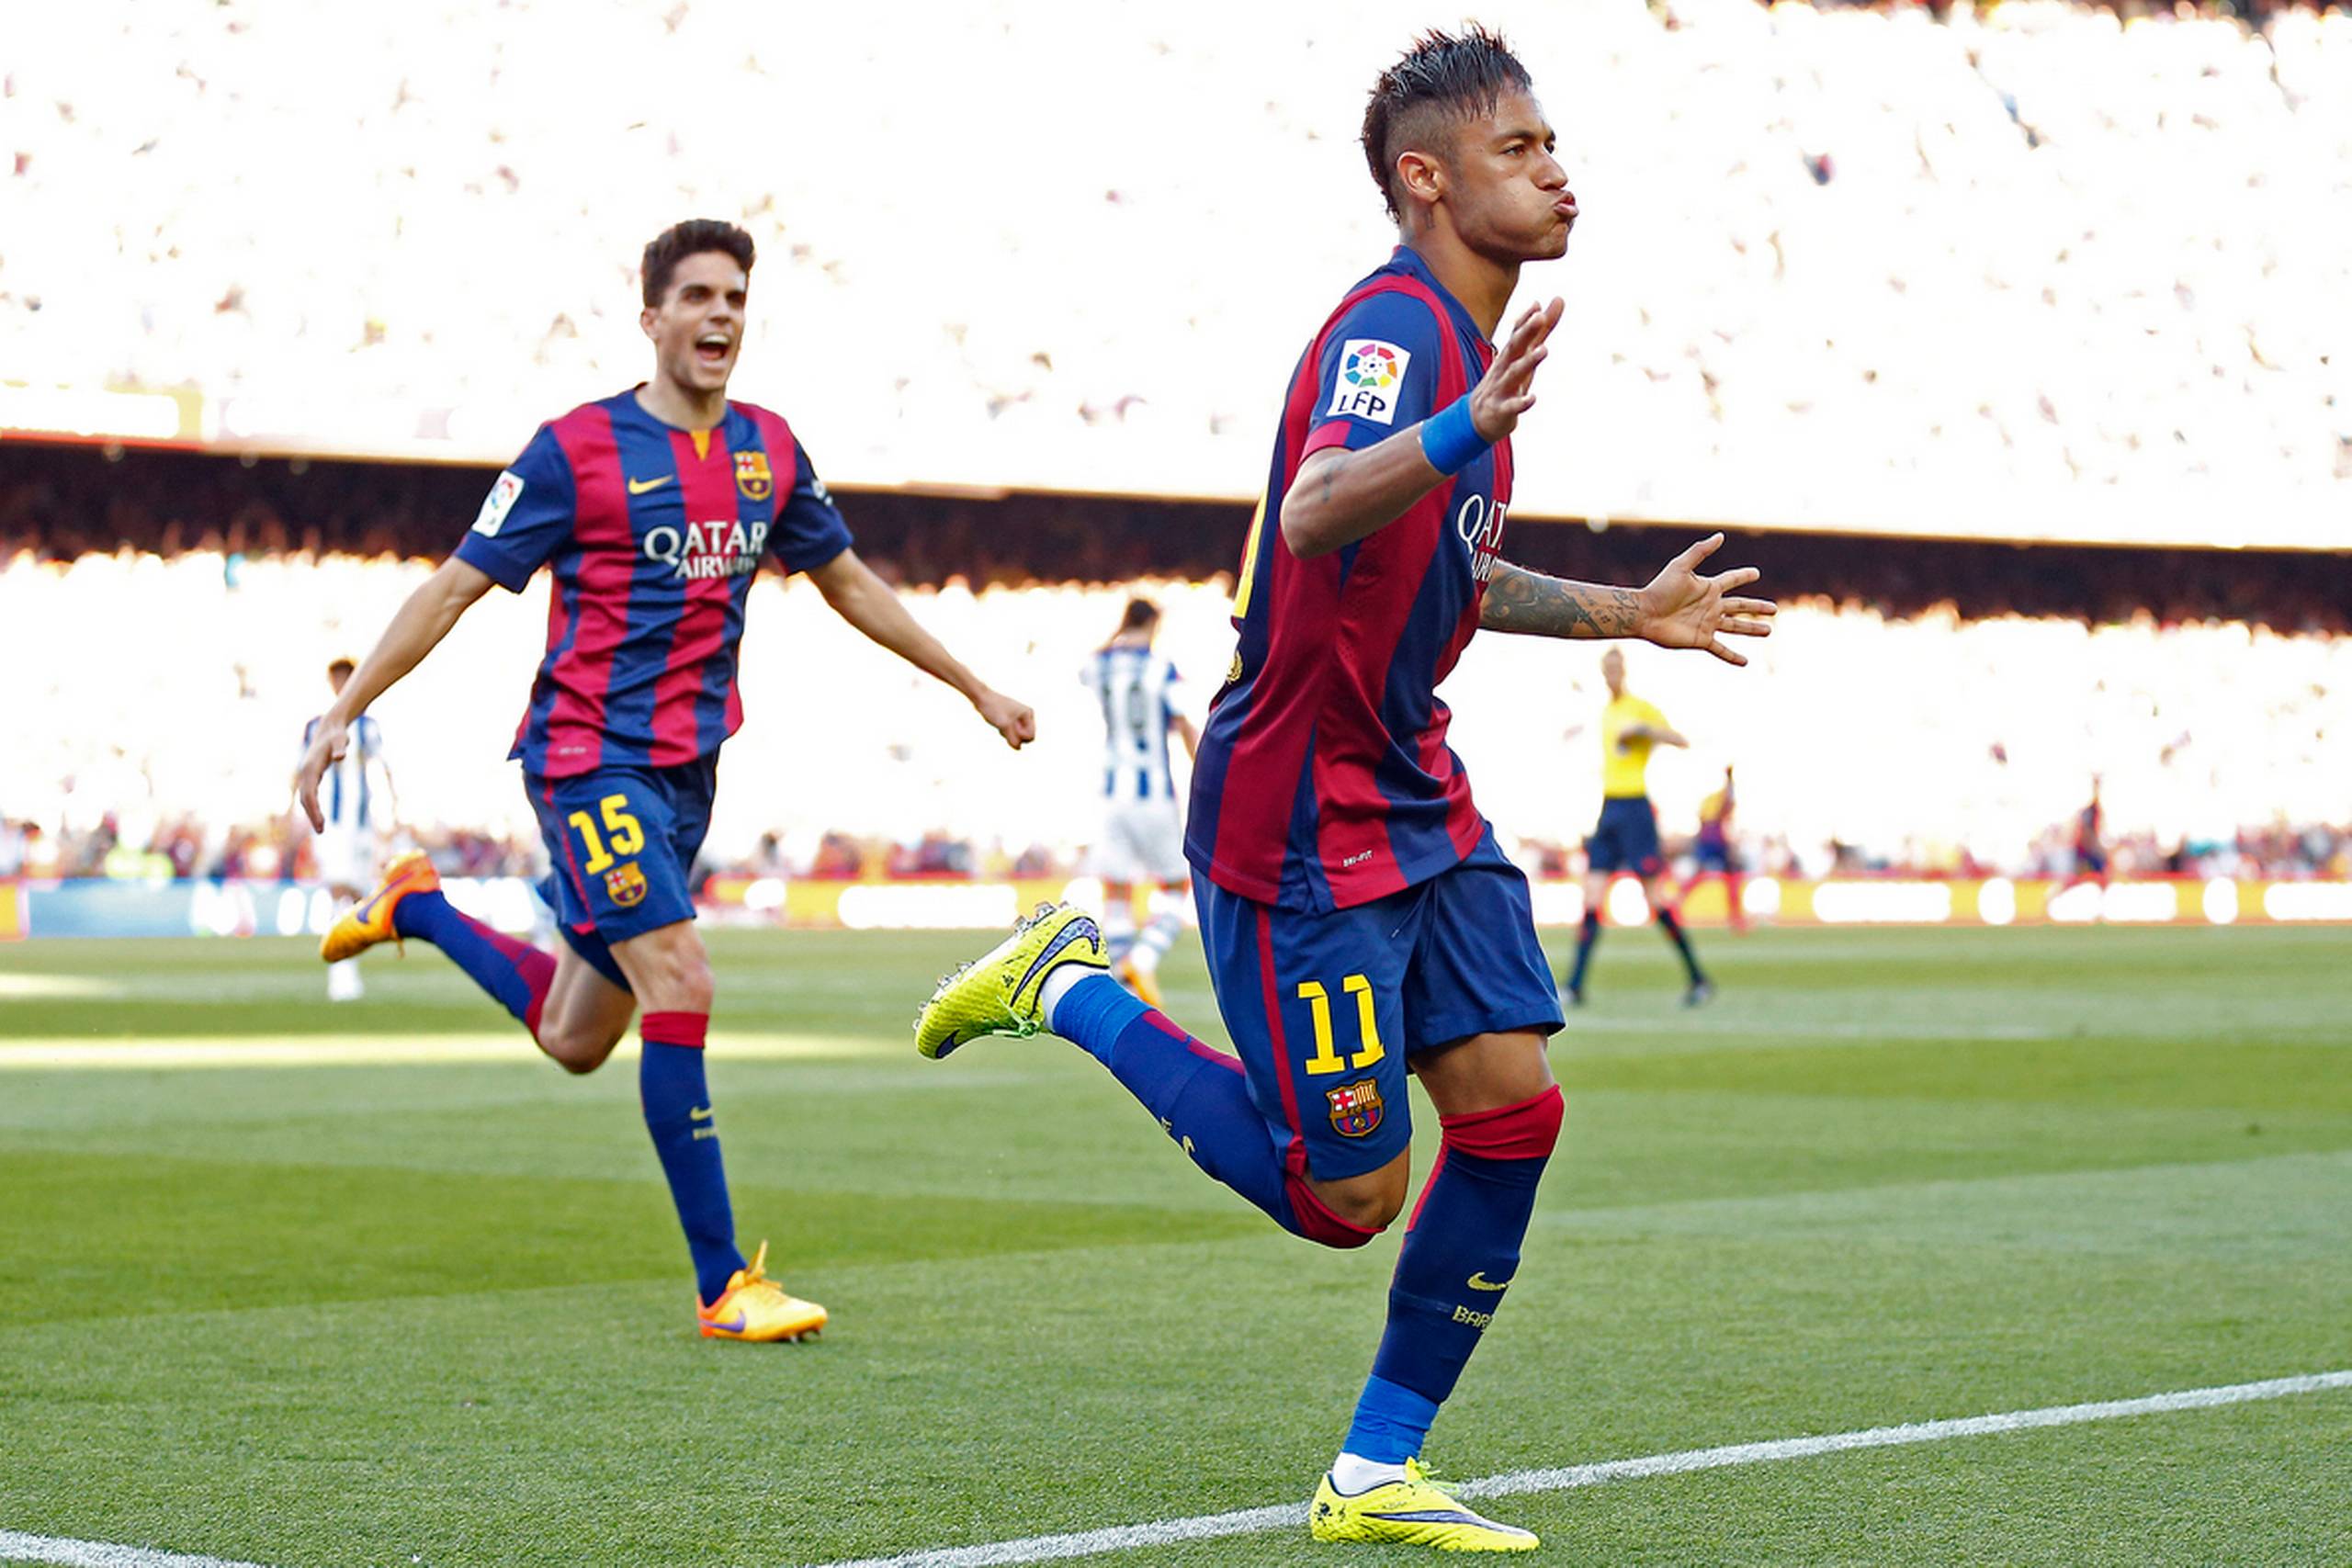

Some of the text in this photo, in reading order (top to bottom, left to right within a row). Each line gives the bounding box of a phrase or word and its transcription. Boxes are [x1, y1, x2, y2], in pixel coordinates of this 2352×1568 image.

[1338, 390, 1386, 416] LFP
[643, 520, 768, 567] QATAR
[569, 795, 644, 874] 15
[1298, 975, 1385, 1075] 11
